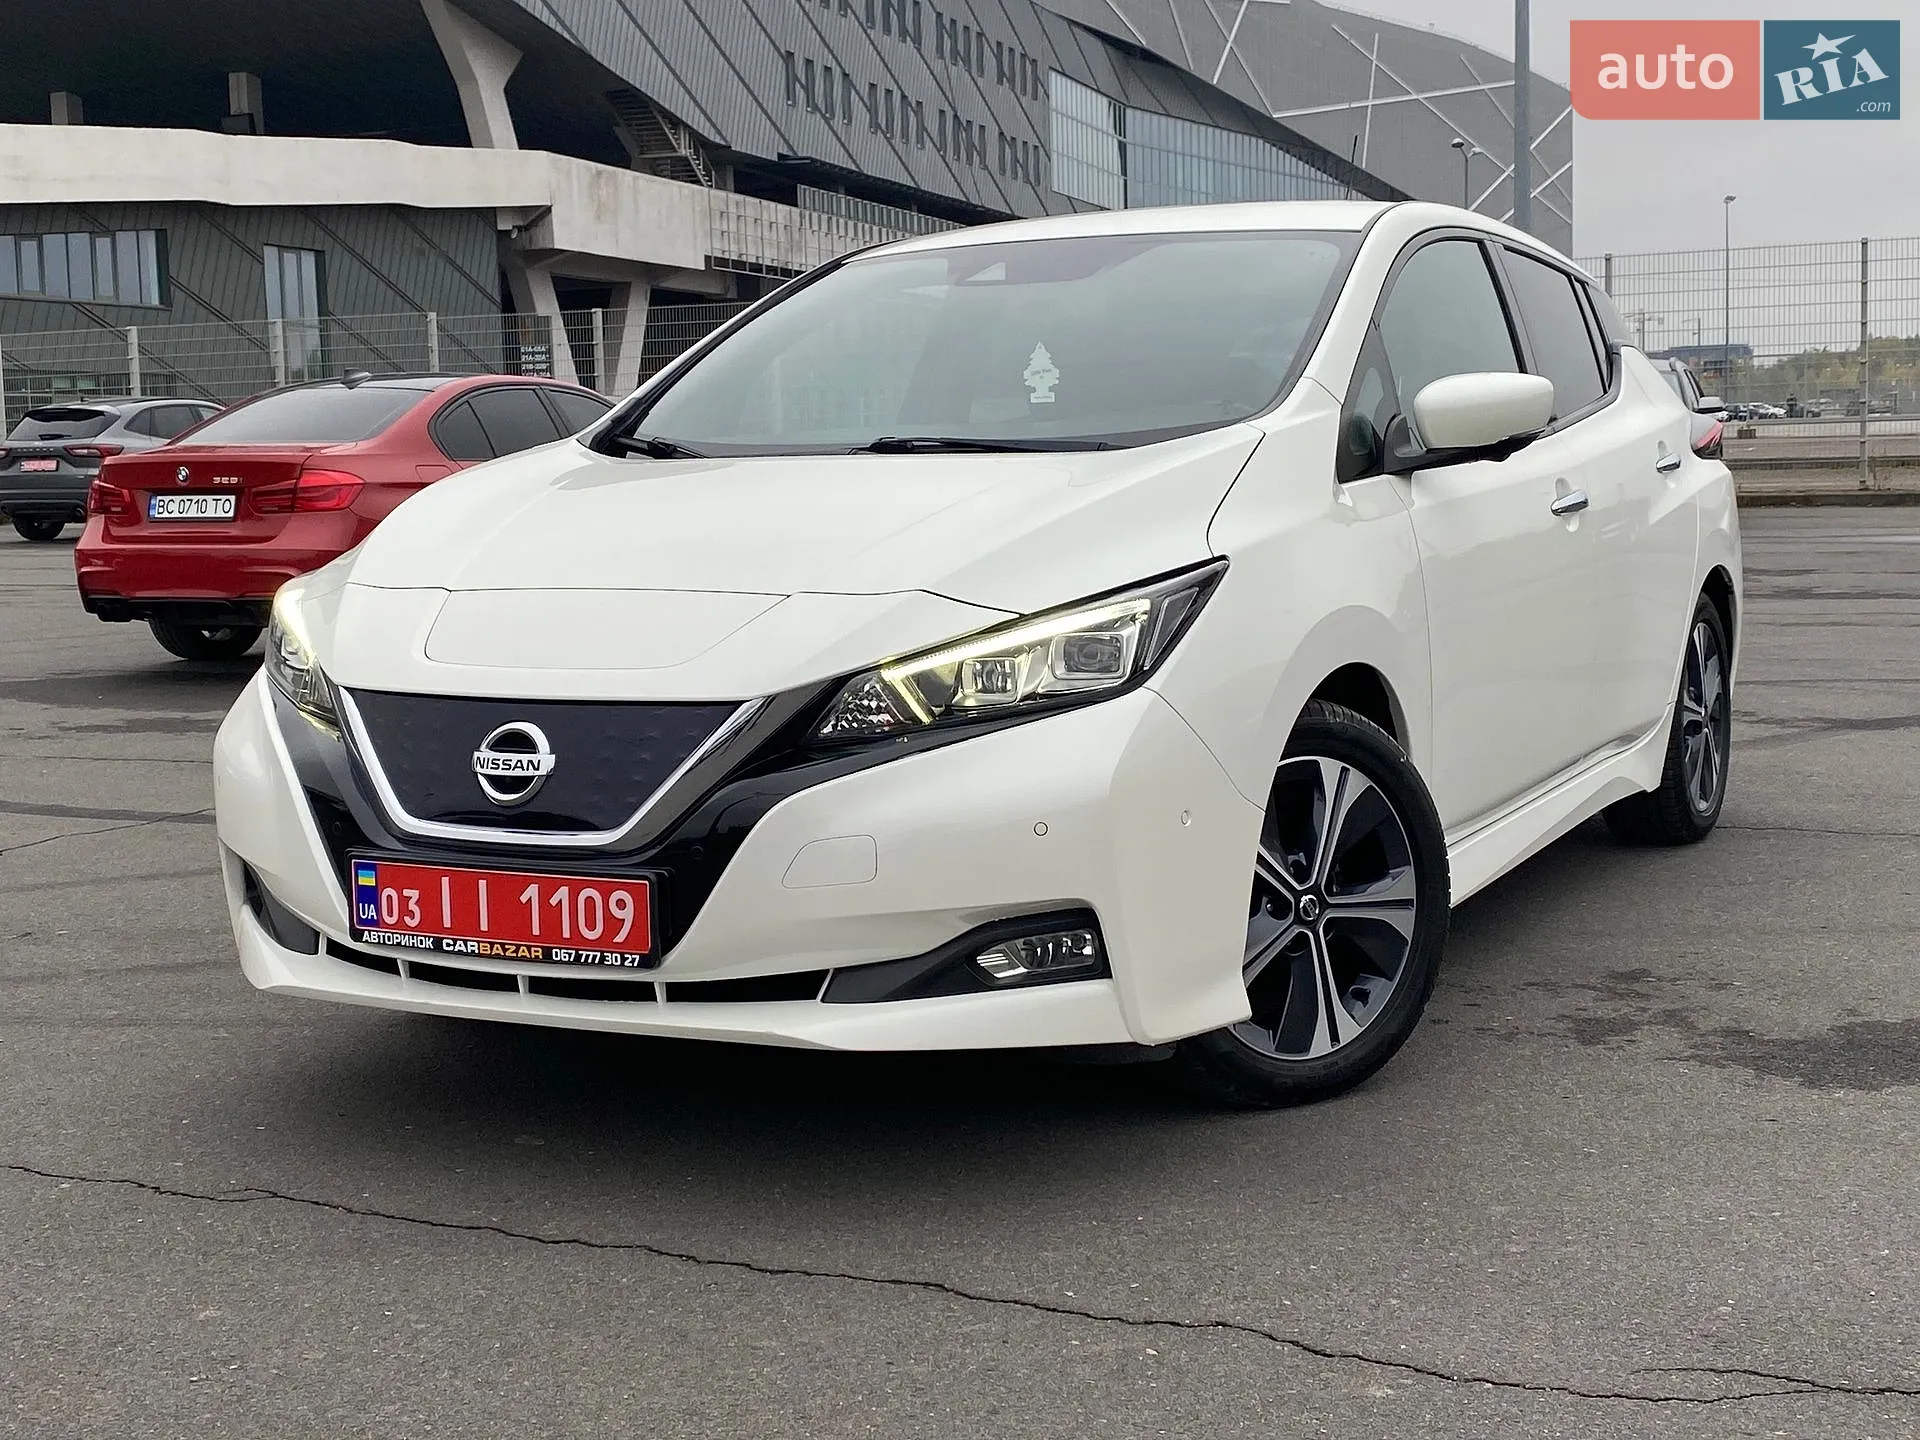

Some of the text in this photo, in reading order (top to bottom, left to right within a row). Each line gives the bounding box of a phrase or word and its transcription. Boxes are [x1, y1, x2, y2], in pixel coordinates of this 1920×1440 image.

[157, 498, 175, 515] BC
[177, 498, 208, 515] 0710
[212, 498, 232, 515] TO
[475, 755, 541, 772] NISSAN
[359, 902, 377, 920] UA
[380, 887, 421, 928] 03
[519, 883, 635, 943] 1109
[362, 930, 640, 967] АВТОРИНОК CARBAZAR 067 777 30 27
